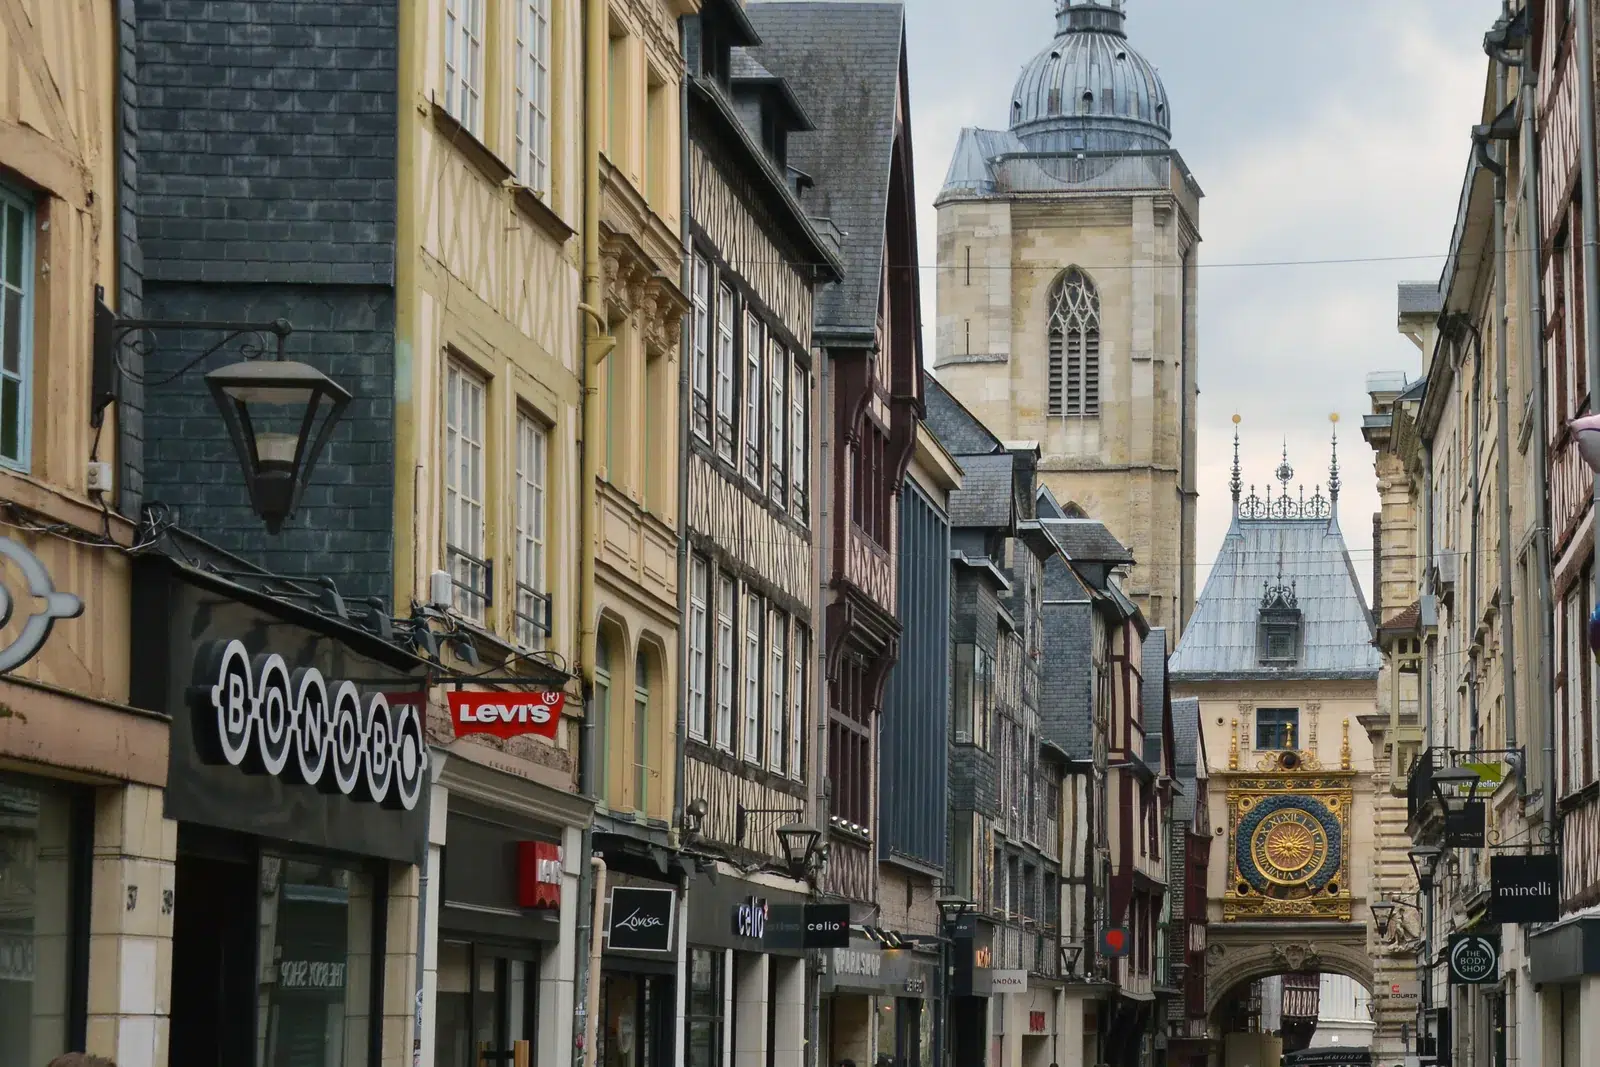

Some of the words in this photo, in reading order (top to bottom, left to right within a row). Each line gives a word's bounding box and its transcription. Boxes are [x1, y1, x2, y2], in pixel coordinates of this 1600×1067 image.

[211, 639, 428, 811] BONOBO
[1500, 882, 1551, 896] minelli
[615, 907, 664, 931] Lovisa
[738, 896, 764, 938] celio
[807, 921, 840, 931] celio
[1460, 957, 1487, 965] BODY
[1461, 965, 1486, 973] SHOP
